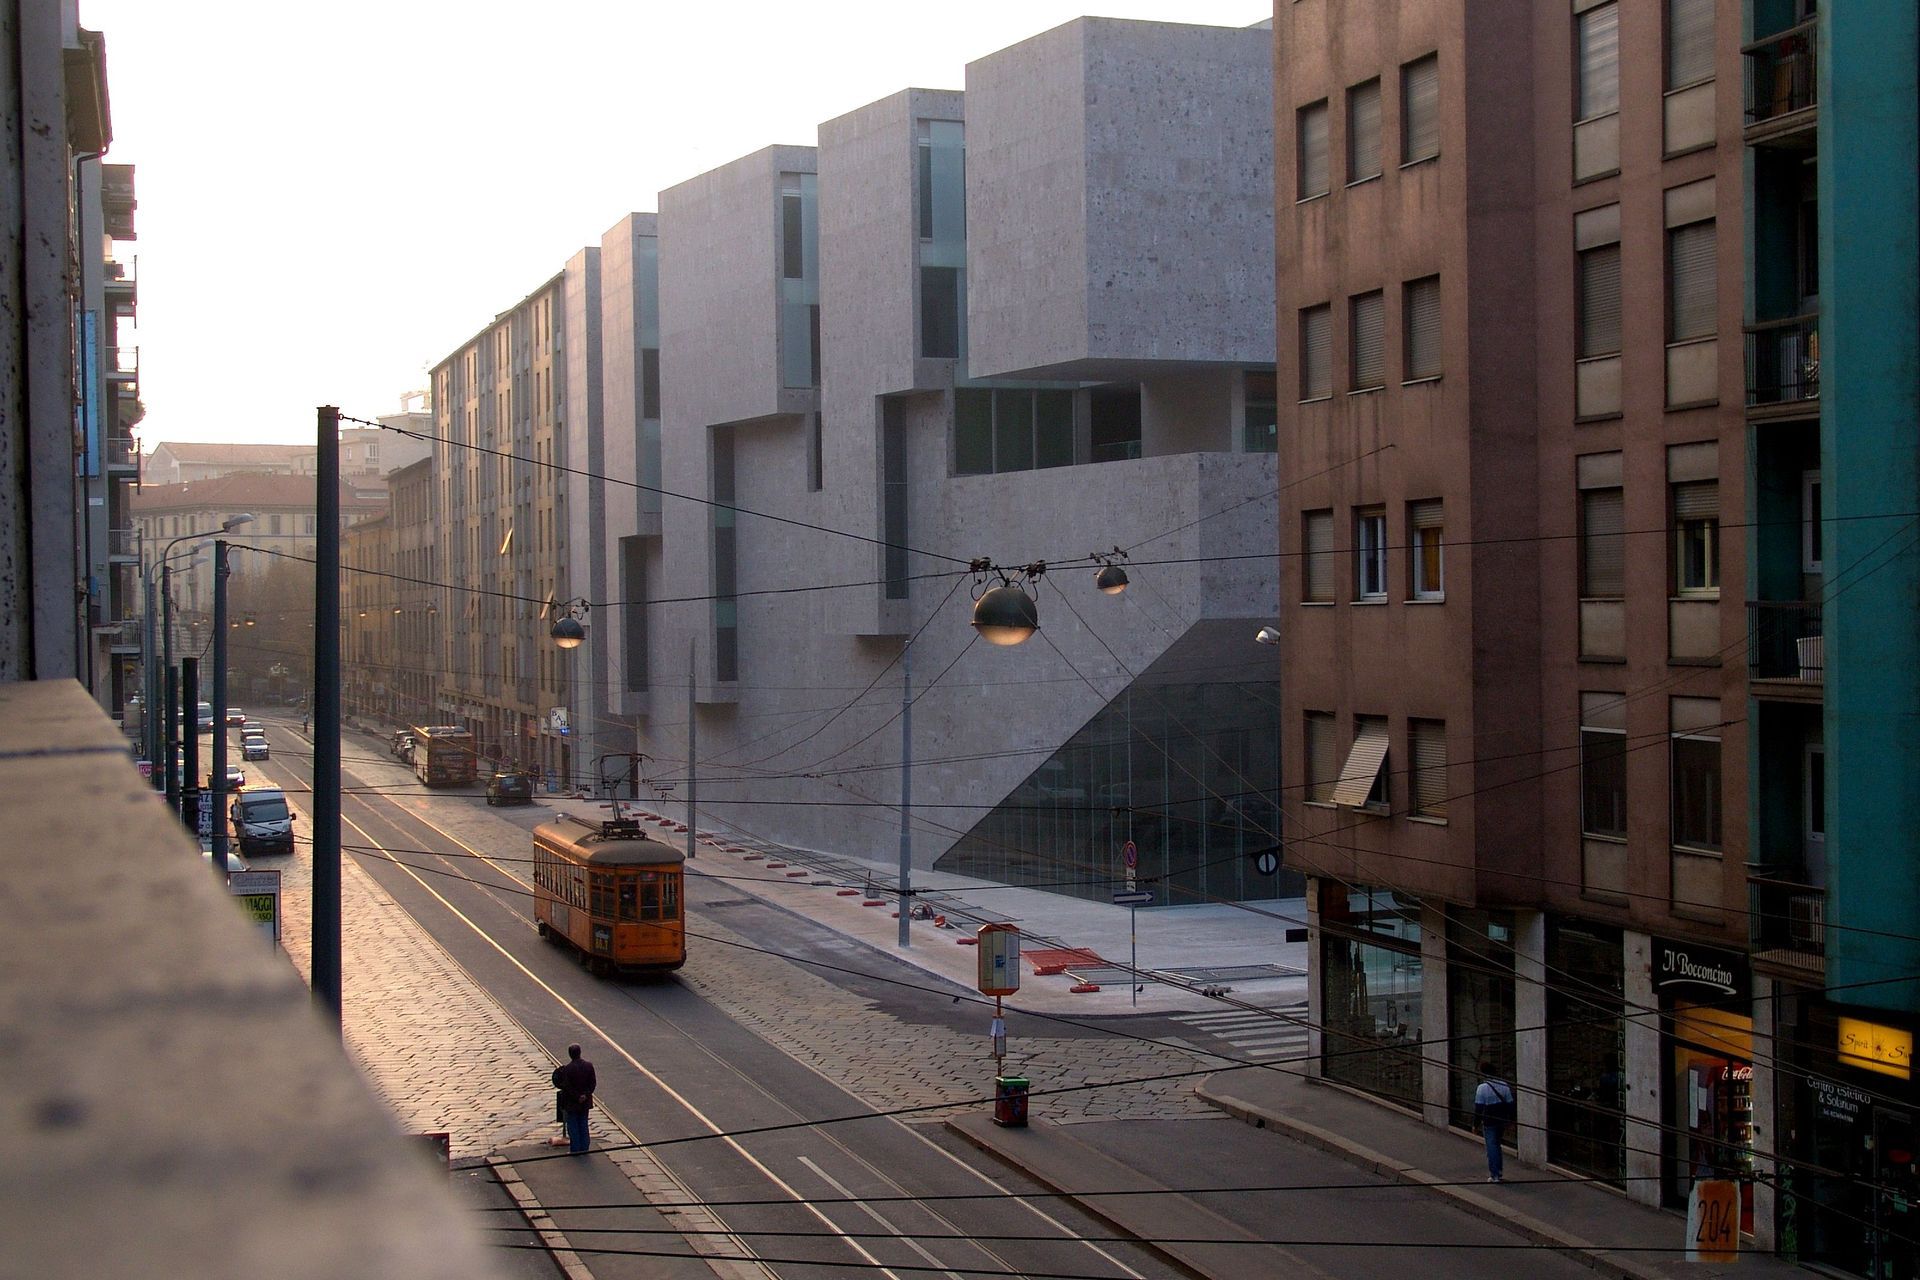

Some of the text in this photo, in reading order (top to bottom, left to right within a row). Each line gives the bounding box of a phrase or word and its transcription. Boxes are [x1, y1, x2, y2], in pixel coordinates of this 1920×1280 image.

[1663, 949, 1732, 985] Il Bocconcino
[1696, 1200, 1731, 1242] 204
